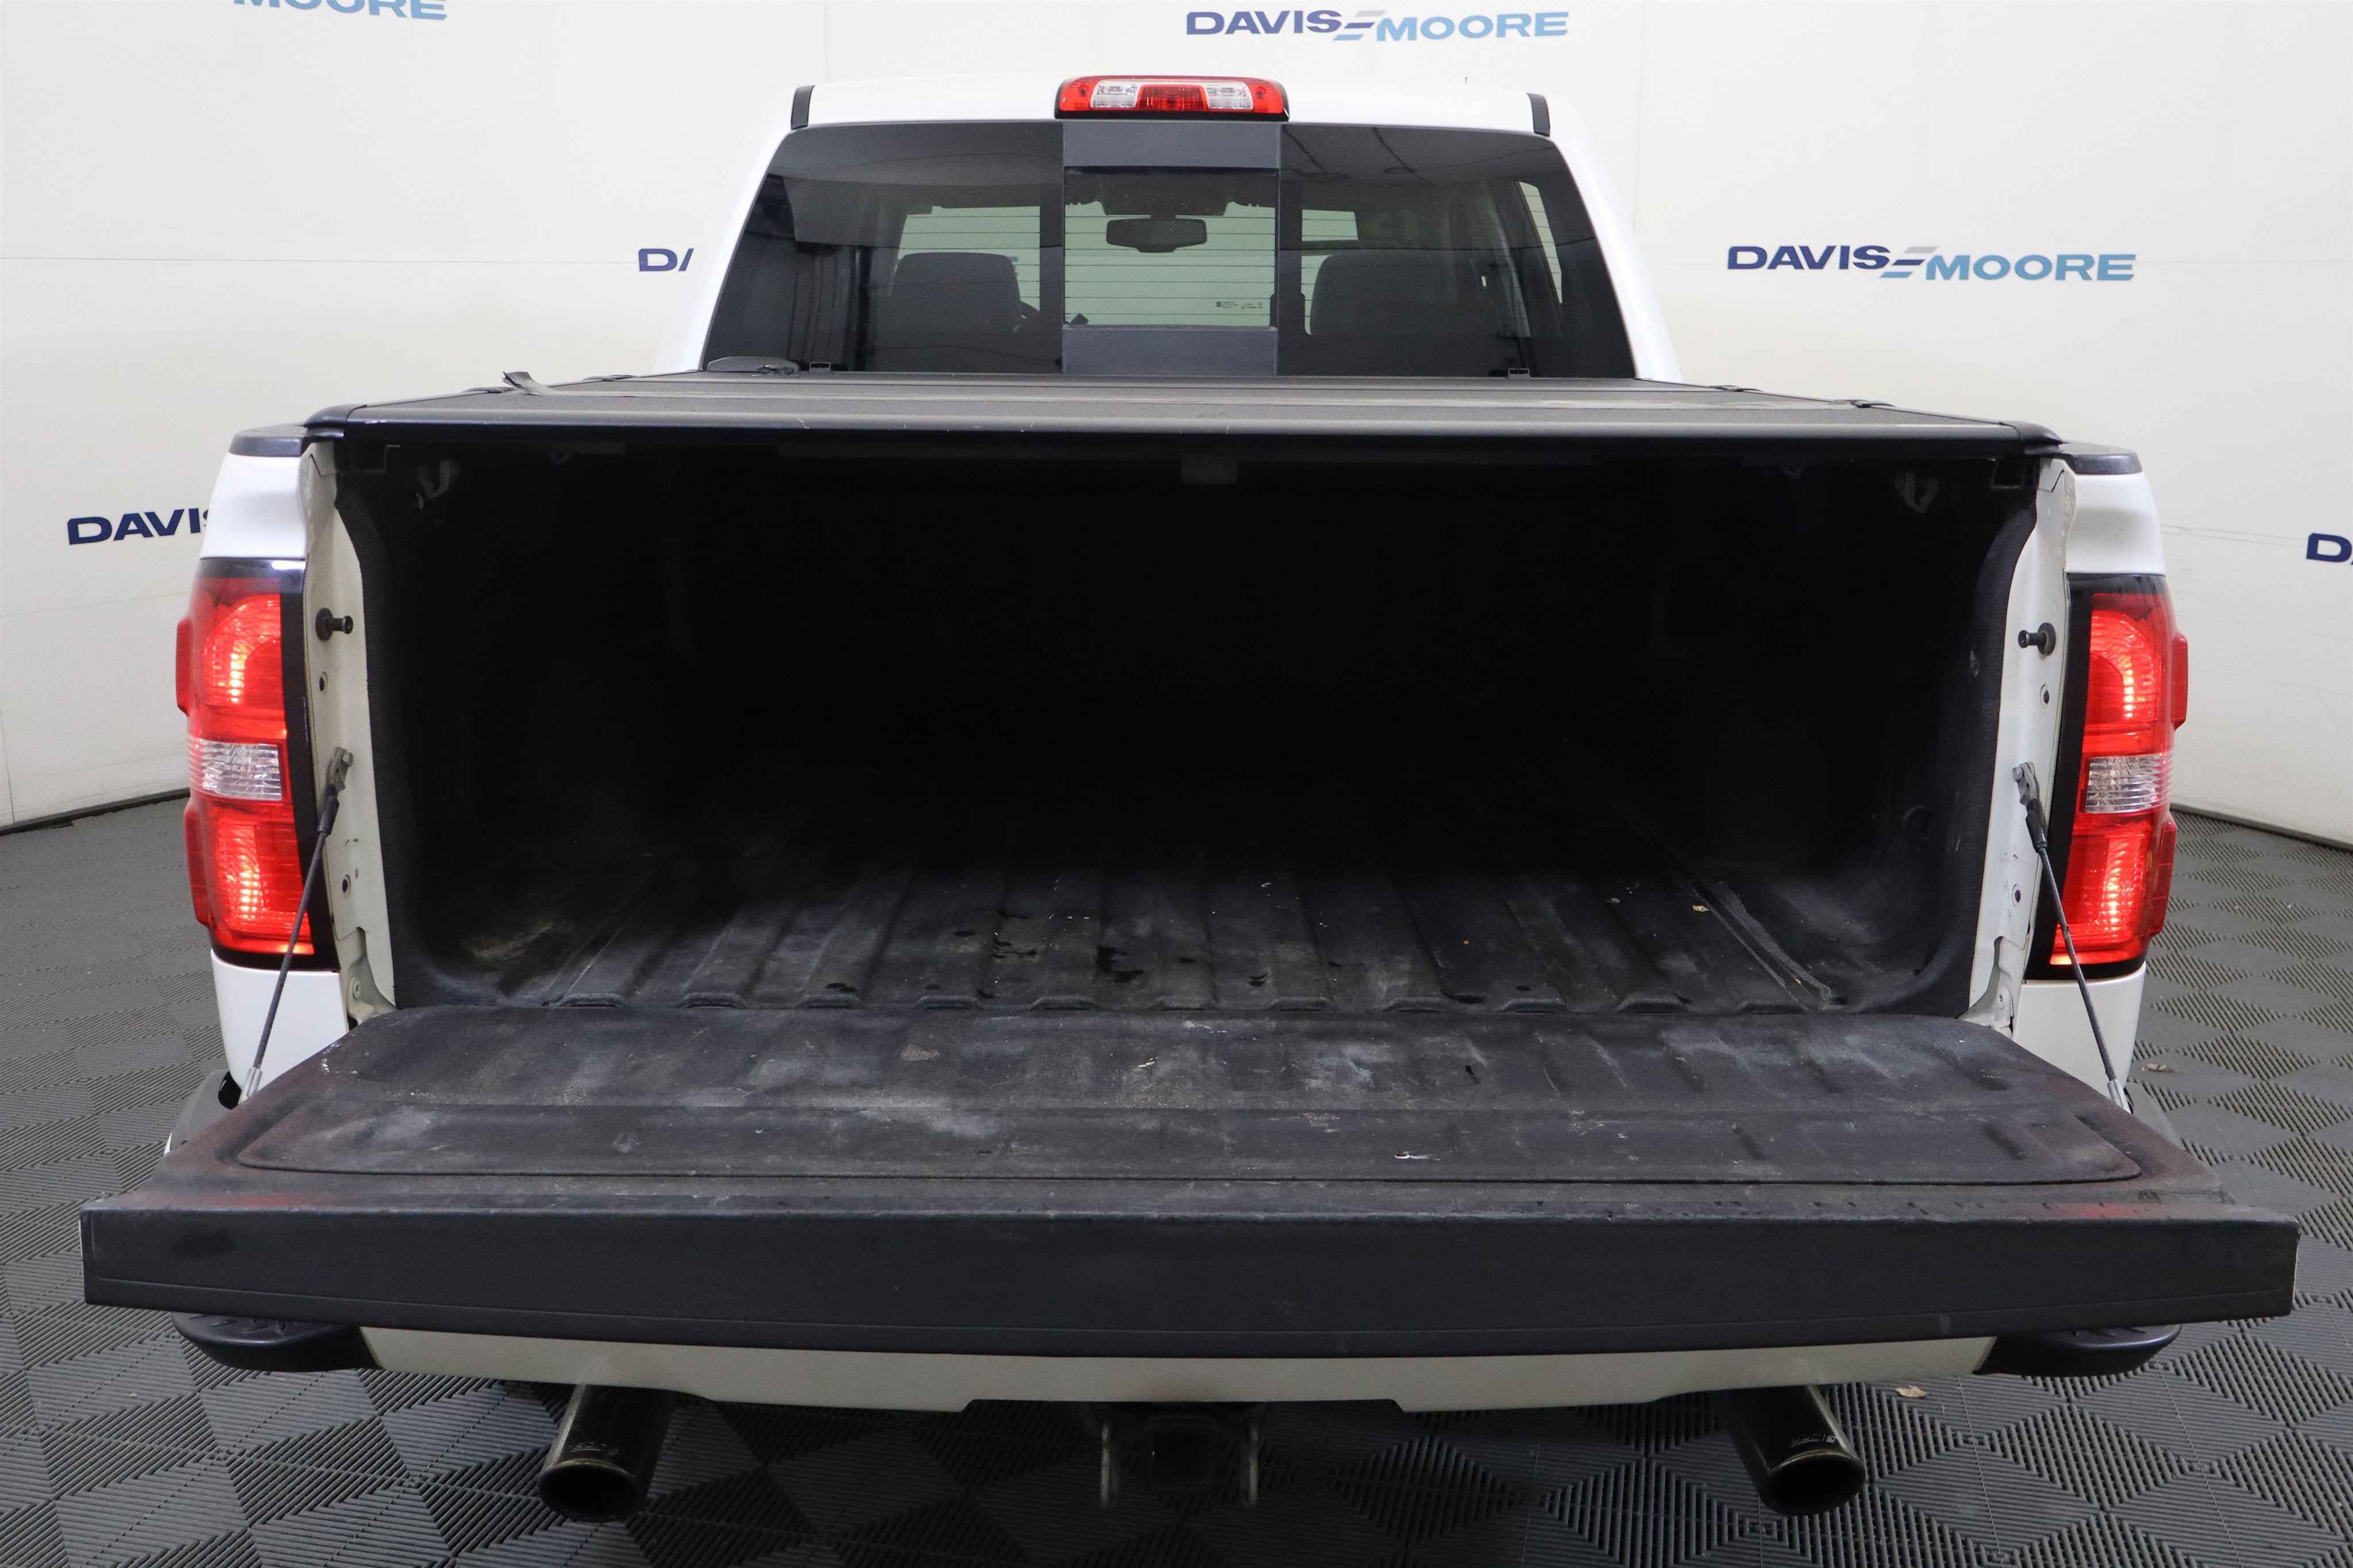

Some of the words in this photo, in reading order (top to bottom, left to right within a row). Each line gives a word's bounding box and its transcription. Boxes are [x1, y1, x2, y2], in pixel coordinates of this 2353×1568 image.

[1186, 10, 1341, 34] DAVIS
[1376, 11, 1569, 41] MOORE
[1727, 245, 1890, 270] DAVIS
[1926, 254, 2136, 280] MOORE
